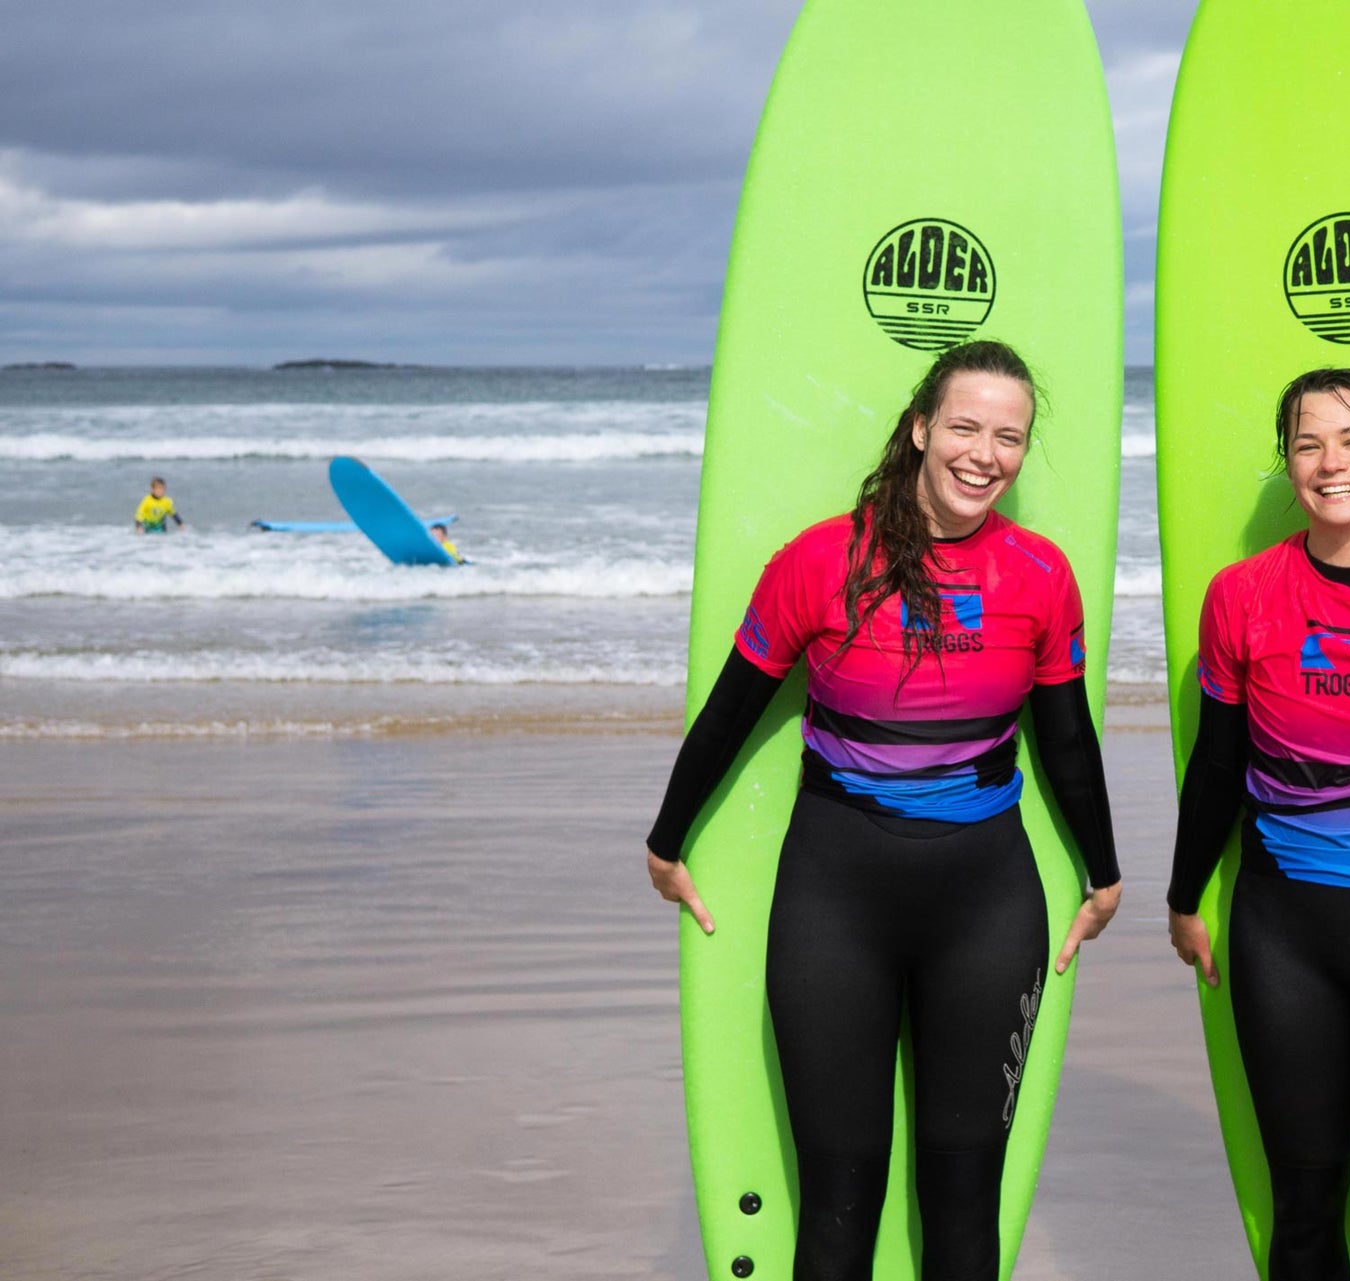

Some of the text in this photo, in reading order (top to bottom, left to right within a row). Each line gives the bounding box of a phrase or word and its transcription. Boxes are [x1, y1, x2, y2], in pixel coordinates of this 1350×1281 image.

[871, 225, 988, 293] ALDER
[906, 302, 950, 315] SSR
[1003, 967, 1042, 1129] Alder
